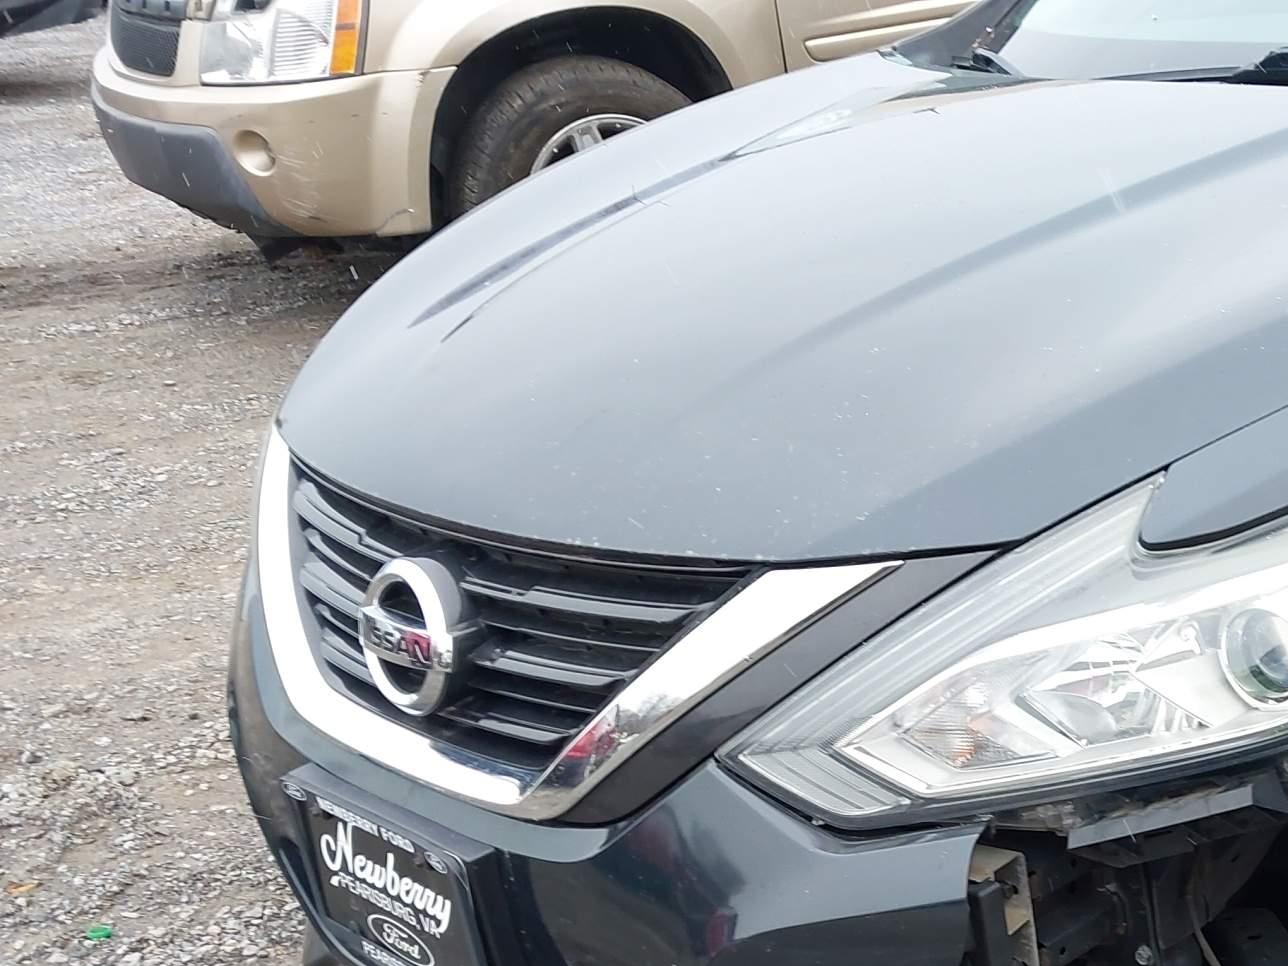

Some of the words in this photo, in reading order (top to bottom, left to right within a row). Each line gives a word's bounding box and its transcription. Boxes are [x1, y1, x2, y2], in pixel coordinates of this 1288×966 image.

[379, 827, 415, 853] FORD
[320, 821, 452, 934] Newberry
[382, 922, 422, 959] Ford
[419, 913, 441, 939] VA
